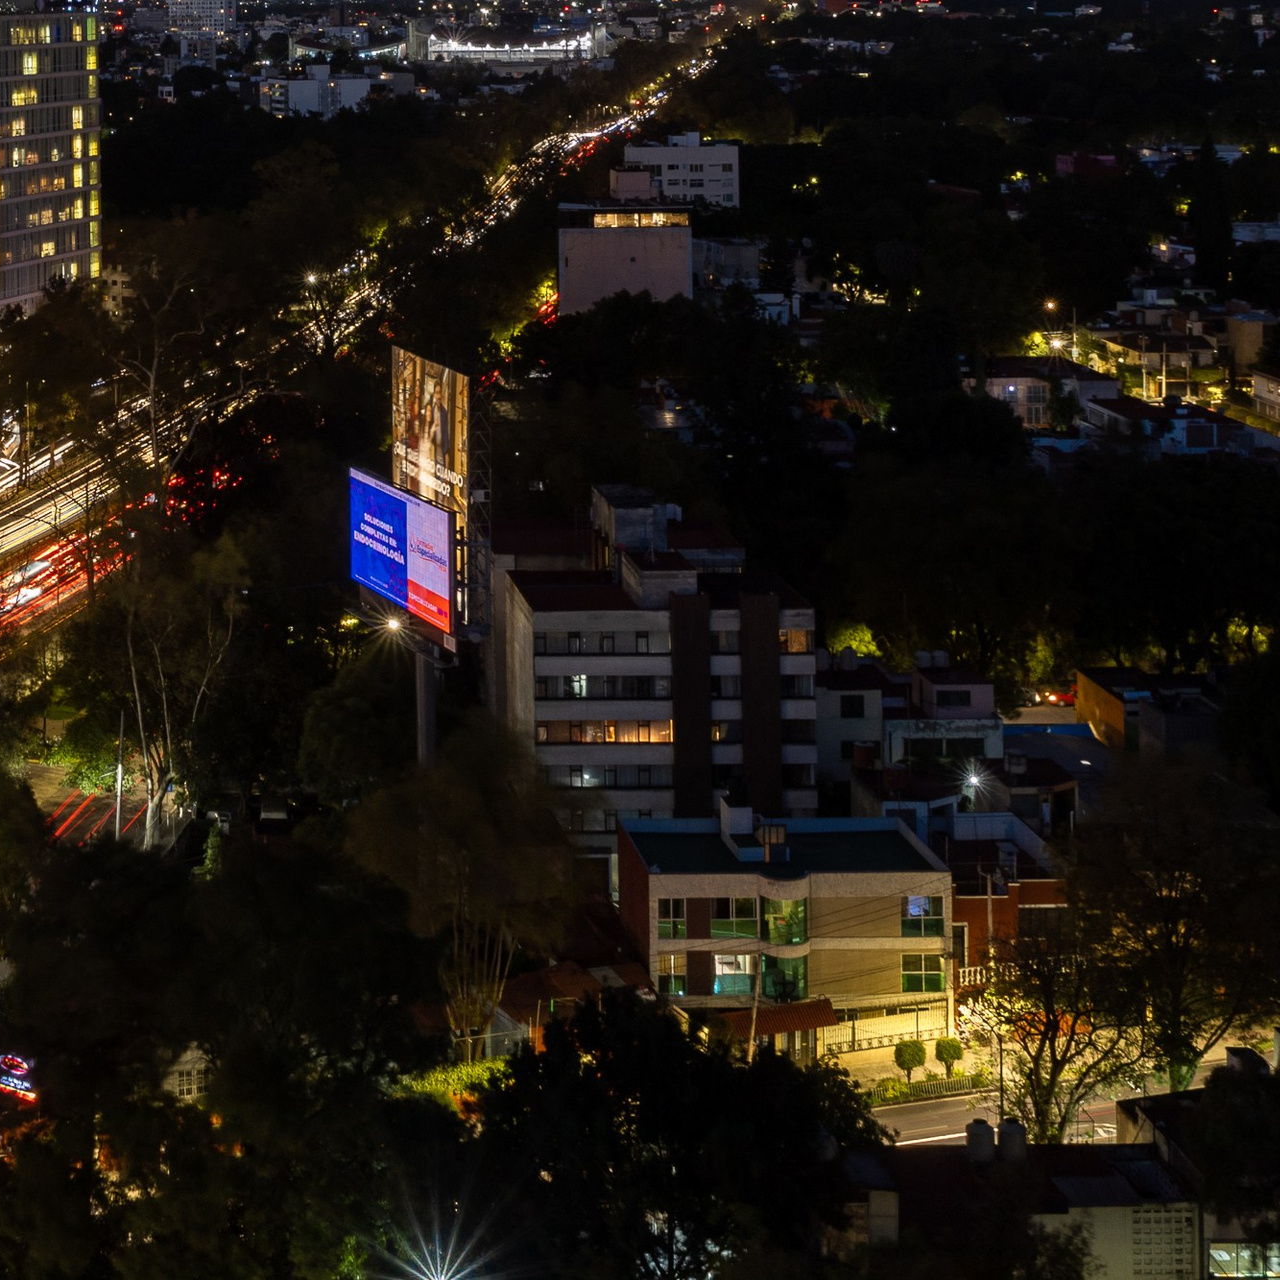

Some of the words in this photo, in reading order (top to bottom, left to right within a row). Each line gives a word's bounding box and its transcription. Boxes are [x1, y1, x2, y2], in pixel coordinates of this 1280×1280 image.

[435, 463, 463, 488] CUANDO
[360, 522, 389, 544] COMPLETAS
[363, 512, 393, 534] SOLUCIONES
[353, 530, 405, 565] ENDOCRINOLOGÍA
